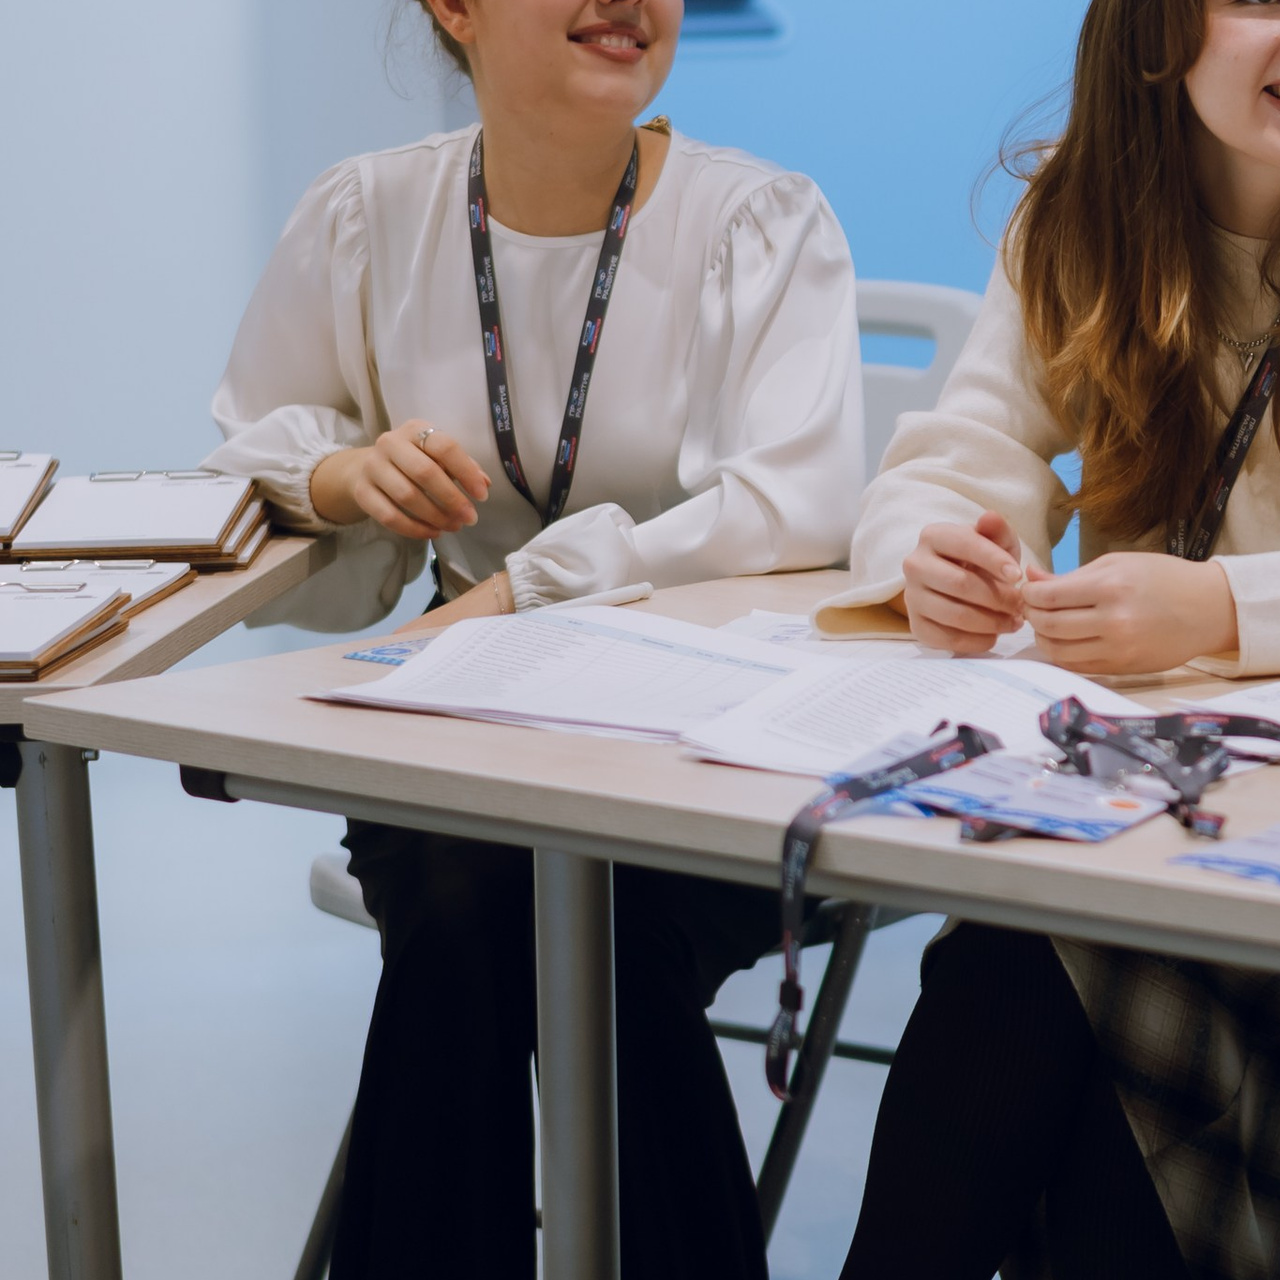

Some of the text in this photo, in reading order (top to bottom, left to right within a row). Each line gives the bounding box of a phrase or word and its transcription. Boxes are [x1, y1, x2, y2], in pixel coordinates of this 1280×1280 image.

[484, 256, 495, 302] РАЗВИТИЕ
[602, 255, 619, 300] РАЗВИТИЕ
[499, 385, 511, 431] РАЗВИТИЕ
[575, 372, 590, 418] РАЗВИТИЕ
[1230, 414, 1252, 460] РАЗВИТИЕ
